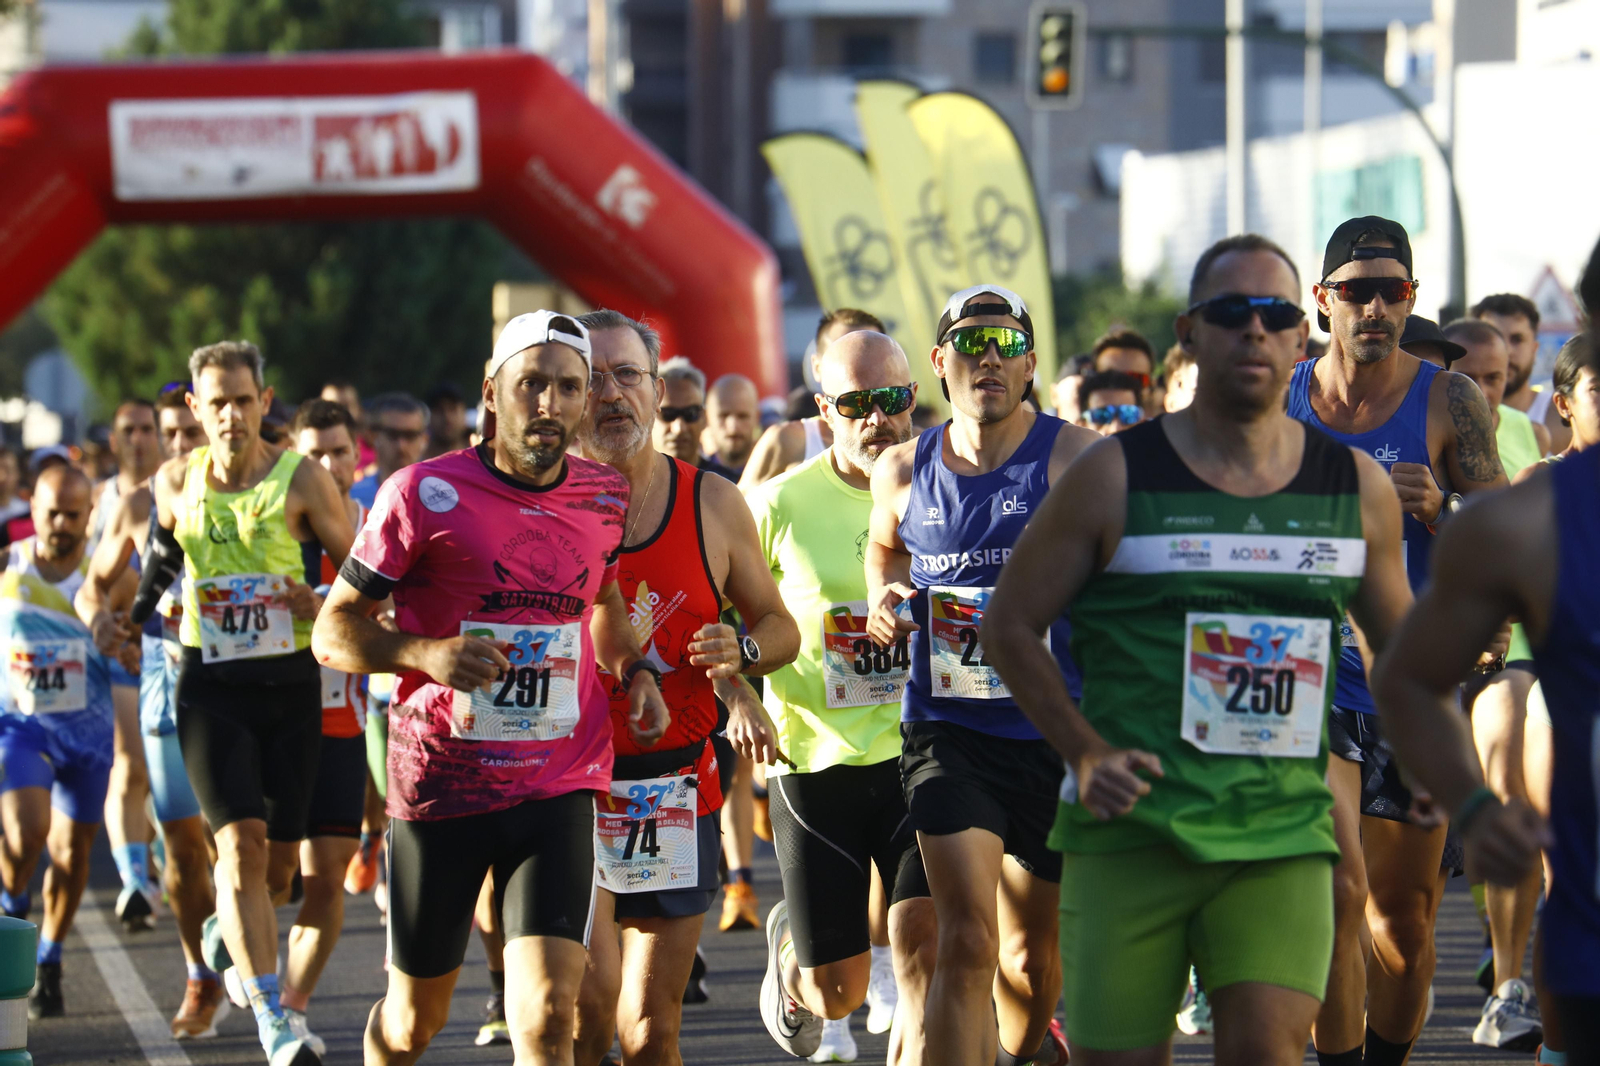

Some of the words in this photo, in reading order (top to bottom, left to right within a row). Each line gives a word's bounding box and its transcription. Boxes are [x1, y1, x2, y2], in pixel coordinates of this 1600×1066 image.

[557, 534, 586, 567] TEAM
[500, 591, 579, 614] SATYSTRAIL
[665, 589, 684, 609] escalada
[221, 603, 269, 635] 478
[853, 636, 911, 676] 384
[24, 667, 66, 690] 244
[493, 667, 551, 708] 291
[1226, 665, 1295, 716] 250
[626, 781, 676, 819] 37º
[622, 819, 661, 860] 74
